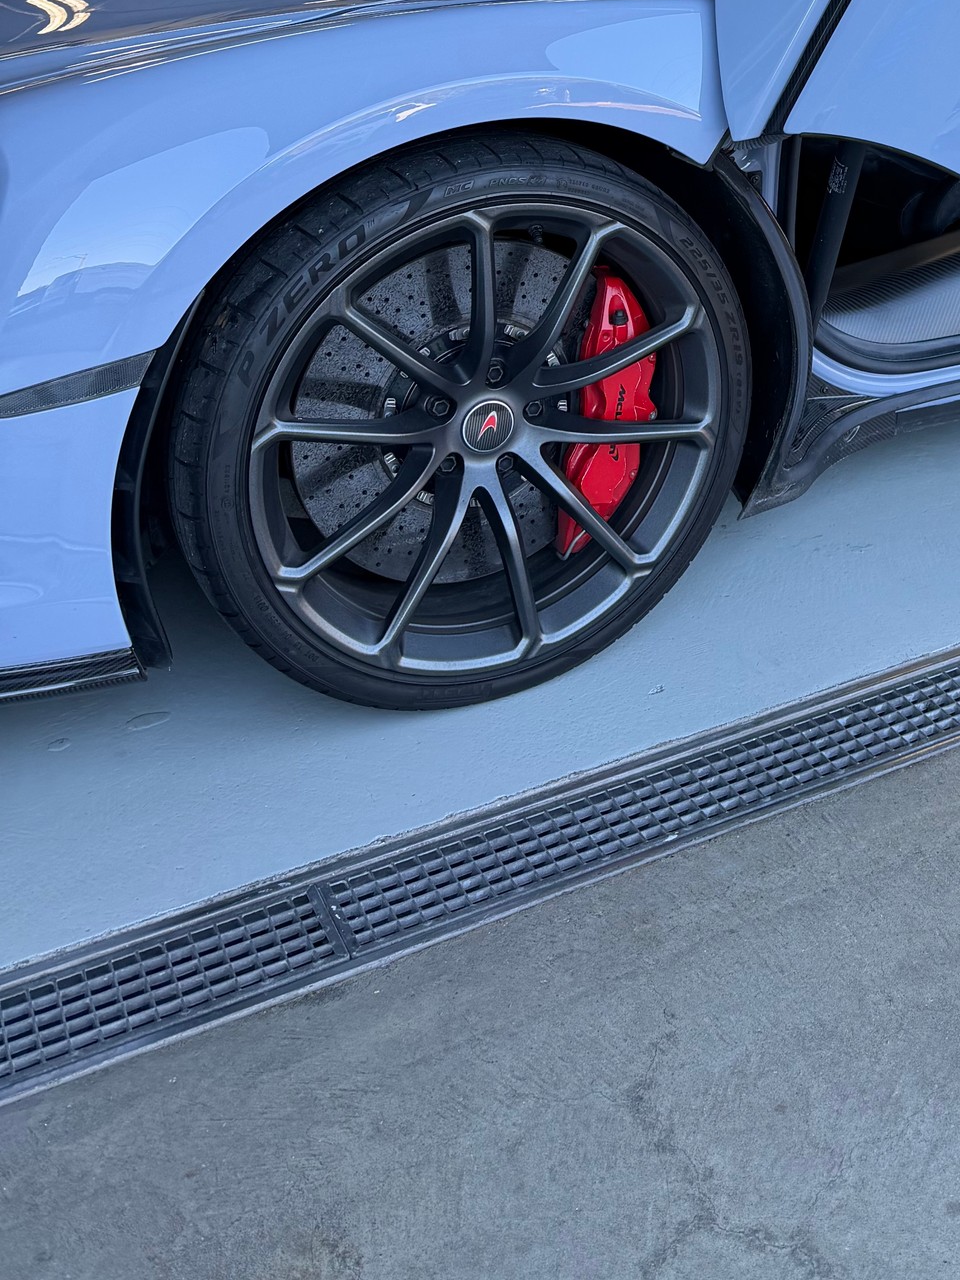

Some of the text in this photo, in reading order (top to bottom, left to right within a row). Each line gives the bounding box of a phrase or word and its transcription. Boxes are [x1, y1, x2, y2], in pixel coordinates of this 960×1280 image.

[444, 180, 474, 197] MC
[488, 176, 528, 188] PNCS
[236, 350, 255, 388] P
[259, 224, 367, 346] ZERO
[679, 235, 730, 305] 225/35
[724, 310, 744, 367] ZR19
